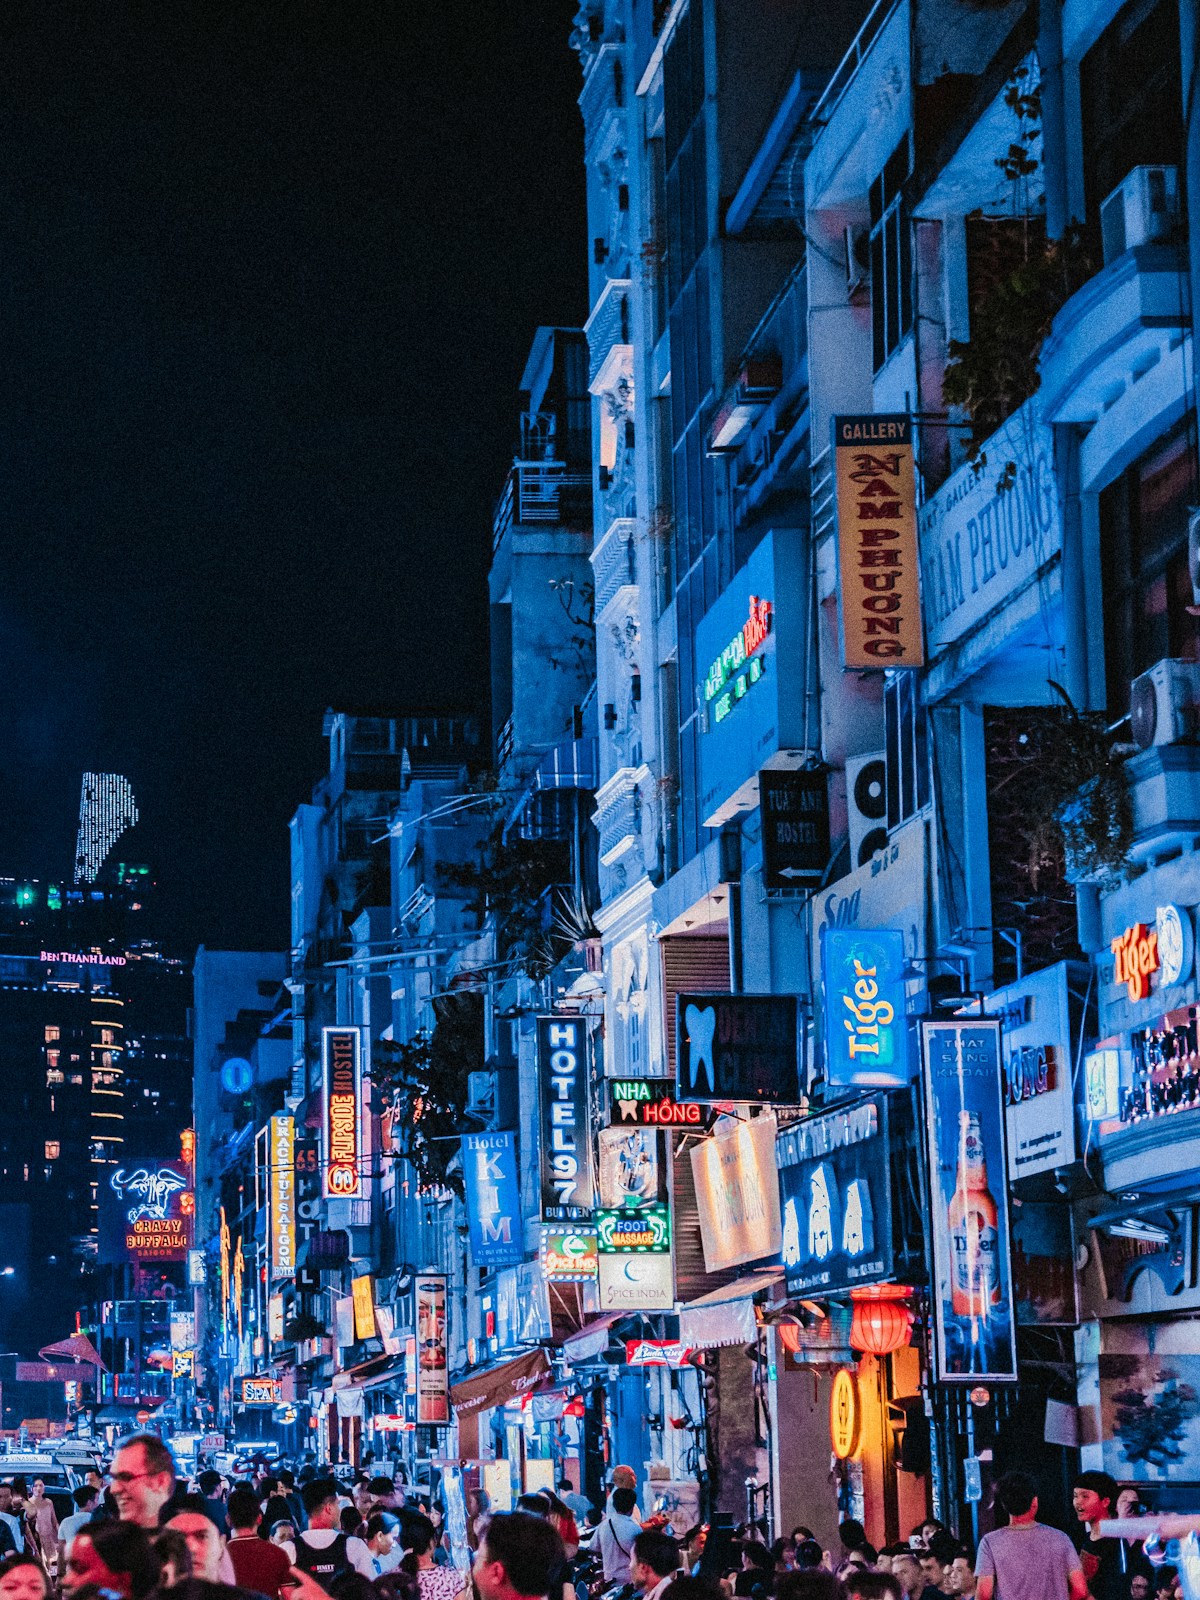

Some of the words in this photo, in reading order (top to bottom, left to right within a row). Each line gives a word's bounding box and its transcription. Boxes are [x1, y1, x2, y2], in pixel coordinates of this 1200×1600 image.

[843, 423, 906, 440] GALLERY
[849, 453, 905, 520] NAM
[40, 951, 60, 962] BEN
[60, 952, 98, 964] THANH
[99, 954, 127, 966] LAND
[1111, 922, 1160, 1002] Tiger
[333, 1034, 353, 1093] HOSTEL
[614, 1083, 651, 1100] NHA
[332, 1094, 355, 1162] FLIPSIDE
[468, 1134, 509, 1150] Hotel
[296, 1150, 317, 1172] 65
[475, 1152, 513, 1245] KIM
[134, 1219, 182, 1233] CRAZY
[297, 1179, 320, 1284] HOTL
[617, 1220, 647, 1232] FOOT
[277, 1204, 291, 1267] SAIGON
[613, 1232, 654, 1246] MASSAGE
[954, 1233, 995, 1253] Tier
[274, 1267, 295, 1277] HOTEL
[637, 1289, 668, 1299] INDIA
[245, 1383, 271, 1400] SPA
